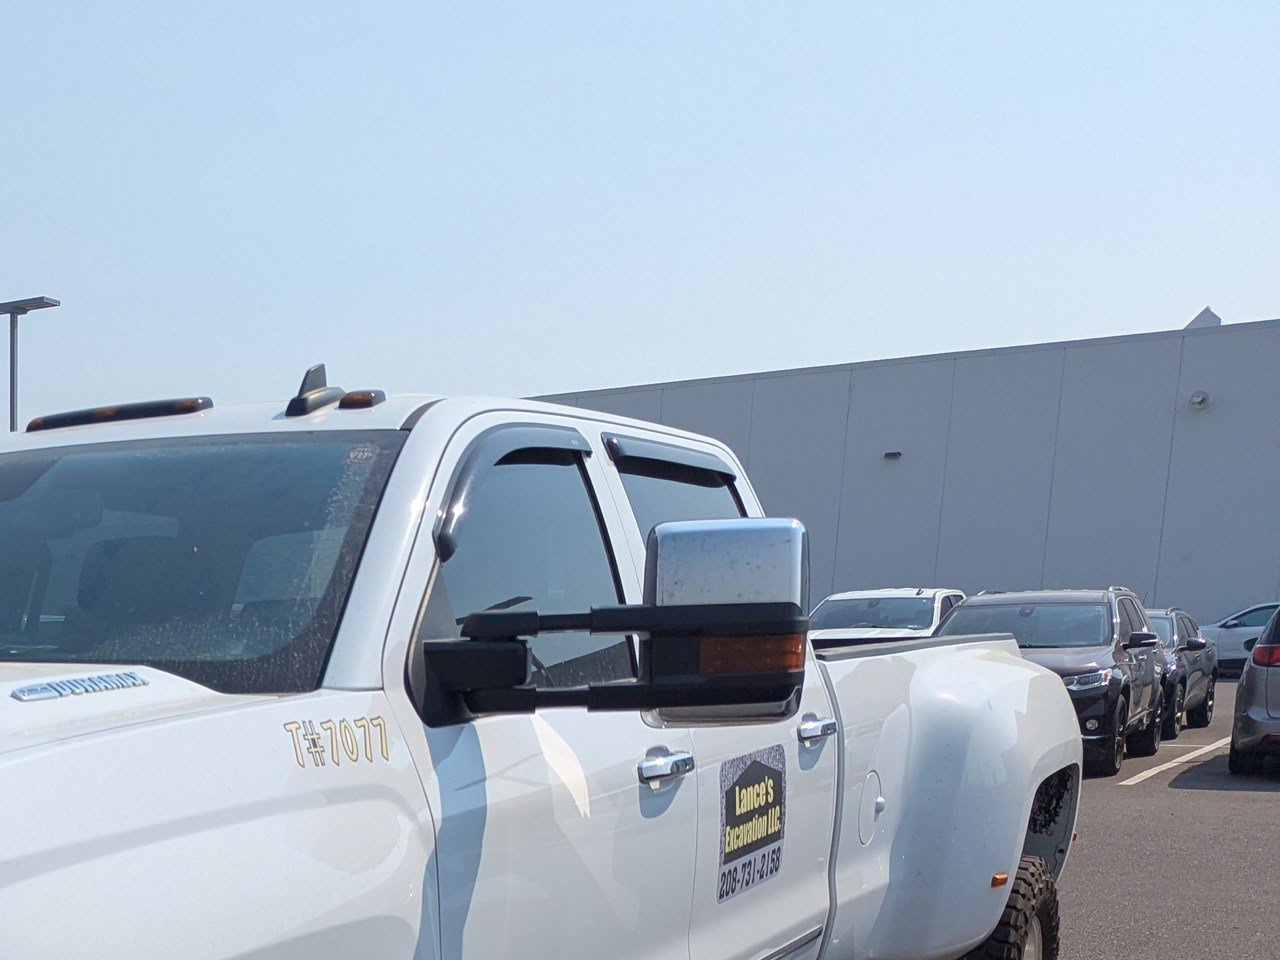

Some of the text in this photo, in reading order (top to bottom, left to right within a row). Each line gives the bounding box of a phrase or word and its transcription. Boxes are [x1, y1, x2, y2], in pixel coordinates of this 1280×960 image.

[283, 715, 389, 768] T#7077
[735, 775, 774, 816] Lance's
[725, 814, 768, 854] Excavation
[719, 846, 781, 900] 208-731-2158
